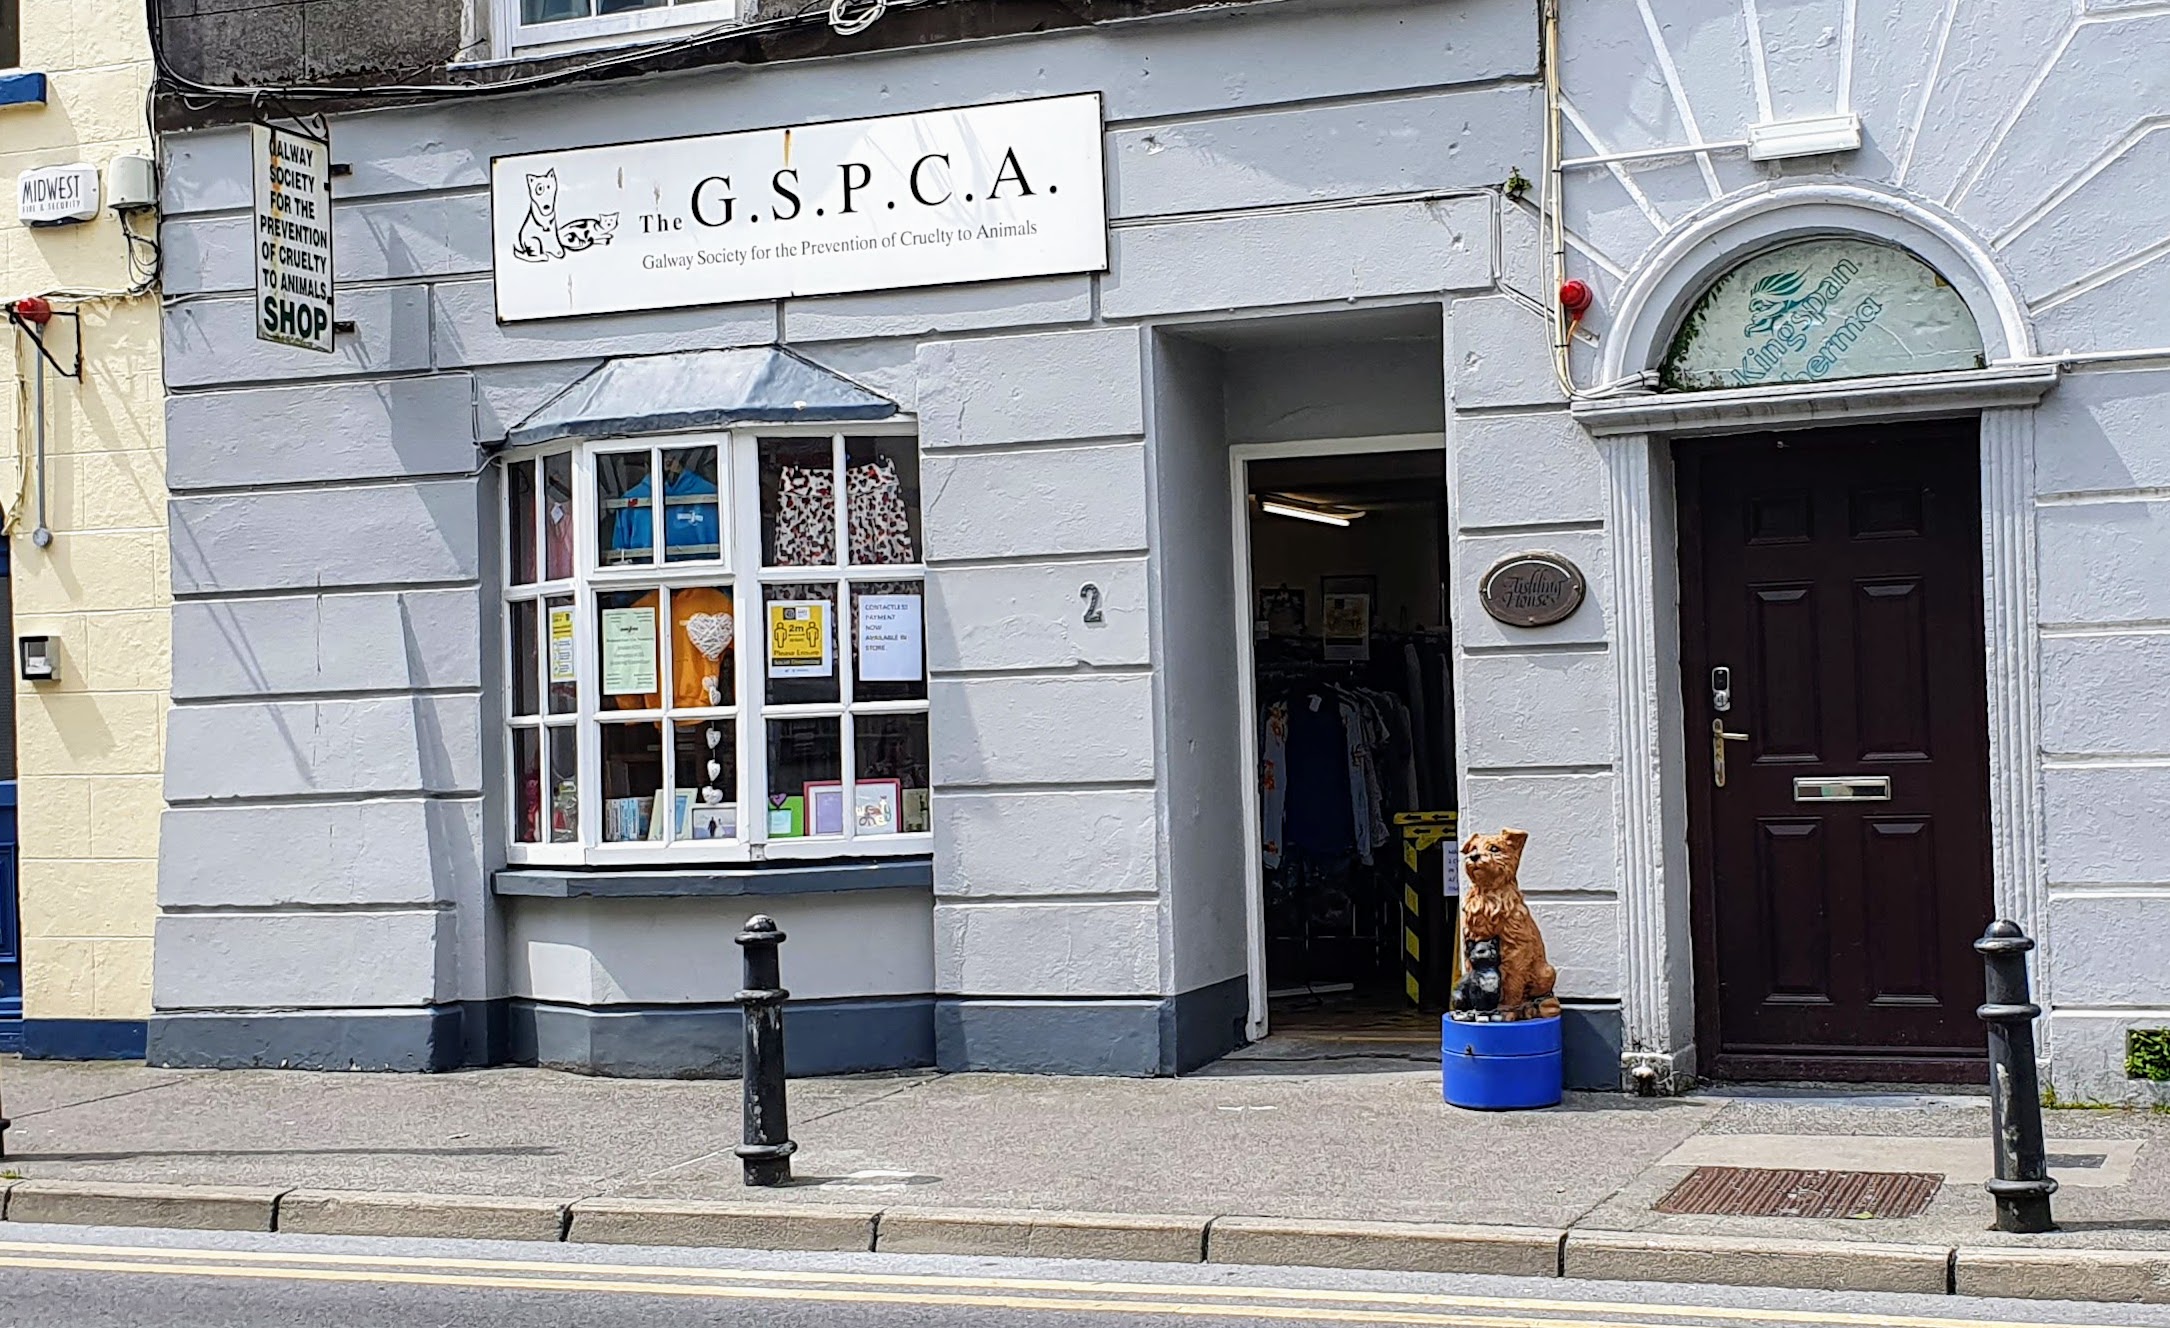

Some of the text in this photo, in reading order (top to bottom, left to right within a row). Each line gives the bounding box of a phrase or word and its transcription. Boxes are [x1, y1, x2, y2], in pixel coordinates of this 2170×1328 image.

[22, 174, 80, 205] MIDWEST
[269, 164, 316, 194] SOCIETY
[48, 200, 81, 211] SECURITY
[270, 190, 316, 220] FOR THE
[260, 214, 328, 249] PREVENTION
[639, 213, 683, 233] The
[261, 241, 327, 275] OF CRUELTY
[642, 219, 1038, 271] Galway Society for the Prevention of Cruelty to Animals
[262, 268, 327, 301] TO ANIMALS
[263, 295, 328, 341] SHOP
[1731, 258, 1859, 384] Kingspan
[1080, 583, 1103, 623] 2
[788, 624, 804, 632] 2m
